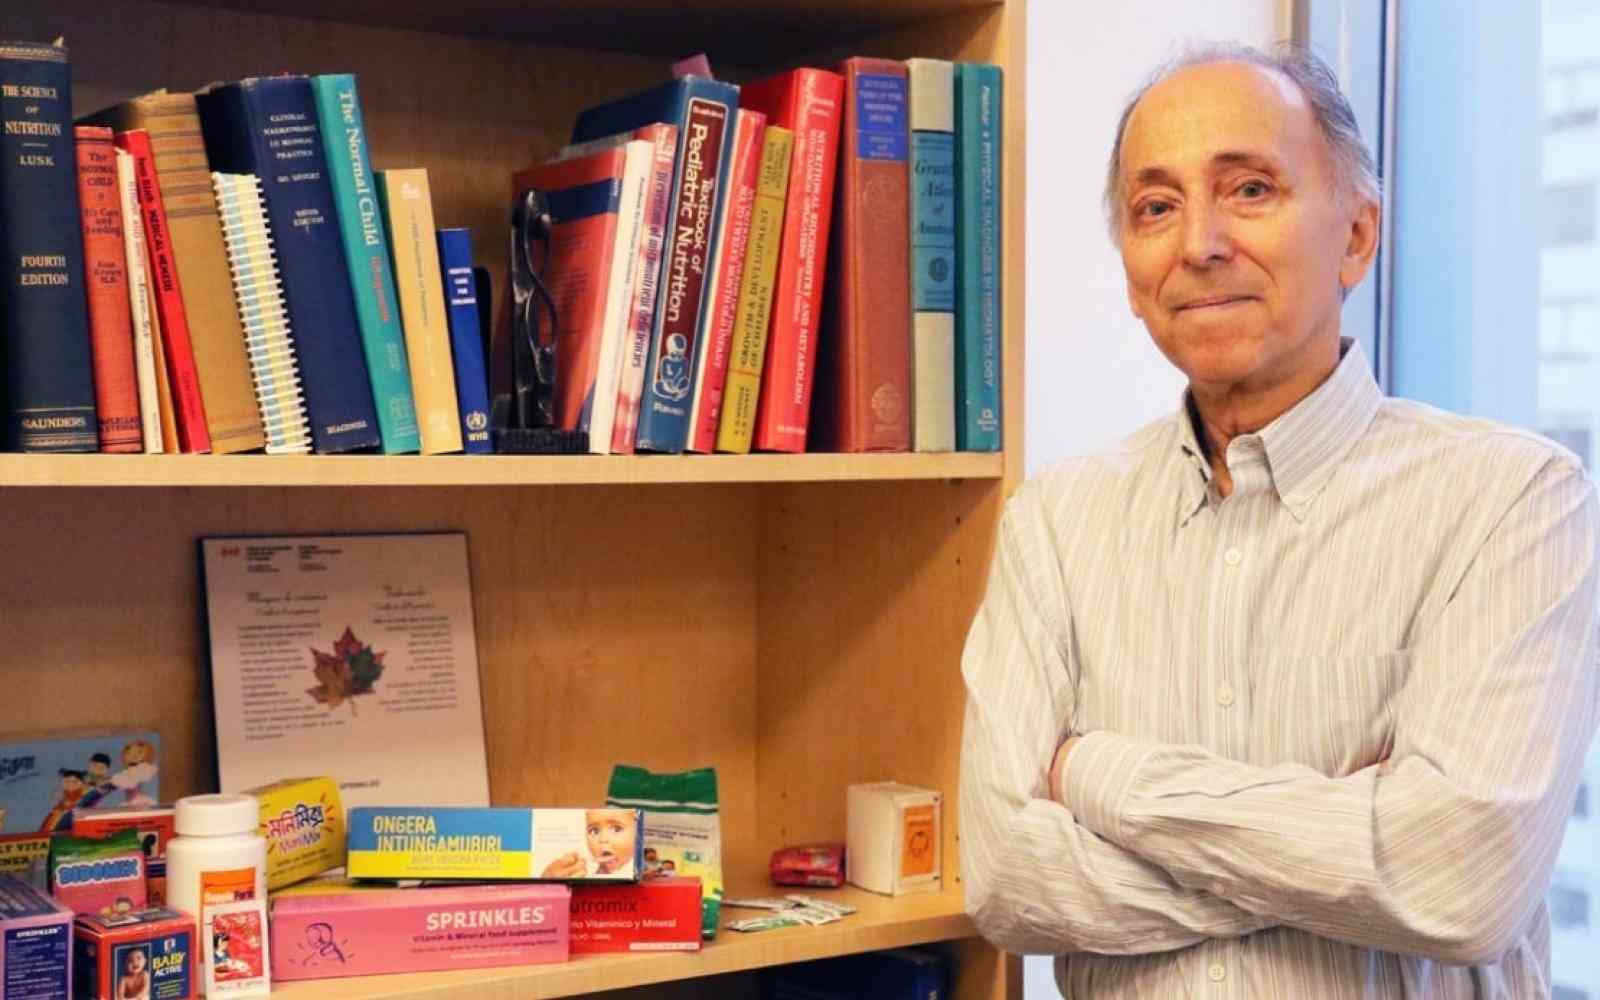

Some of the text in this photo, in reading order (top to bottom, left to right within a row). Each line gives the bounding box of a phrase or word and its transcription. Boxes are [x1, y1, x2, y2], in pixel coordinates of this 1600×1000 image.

[2, 85, 19, 97] THE
[5, 121, 62, 136] NUTRITION
[19, 155, 55, 167] LUSK
[337, 87, 381, 246] The Normal Child
[810, 130, 826, 208] NUTRITIONAL
[666, 122, 708, 323] Pediatric Nutrition
[690, 176, 714, 273] Textbook of
[21, 255, 66, 268] FOURTH
[801, 212, 818, 298] BIOCHEMISTRY
[21, 273, 69, 286] EDITION
[752, 285, 767, 348] CHILDREN
[800, 301, 811, 324] AND
[739, 313, 754, 365] GROWTH
[792, 327, 809, 405] METABOLISM
[373, 815, 437, 834] ONGERA
[377, 835, 502, 856] INTUNGAMUBIRI
[570, 898, 638, 914] utromix
[426, 907, 545, 931] SPRINKLES
[642, 918, 677, 928] Mineral
[152, 952, 184, 970] BABY
